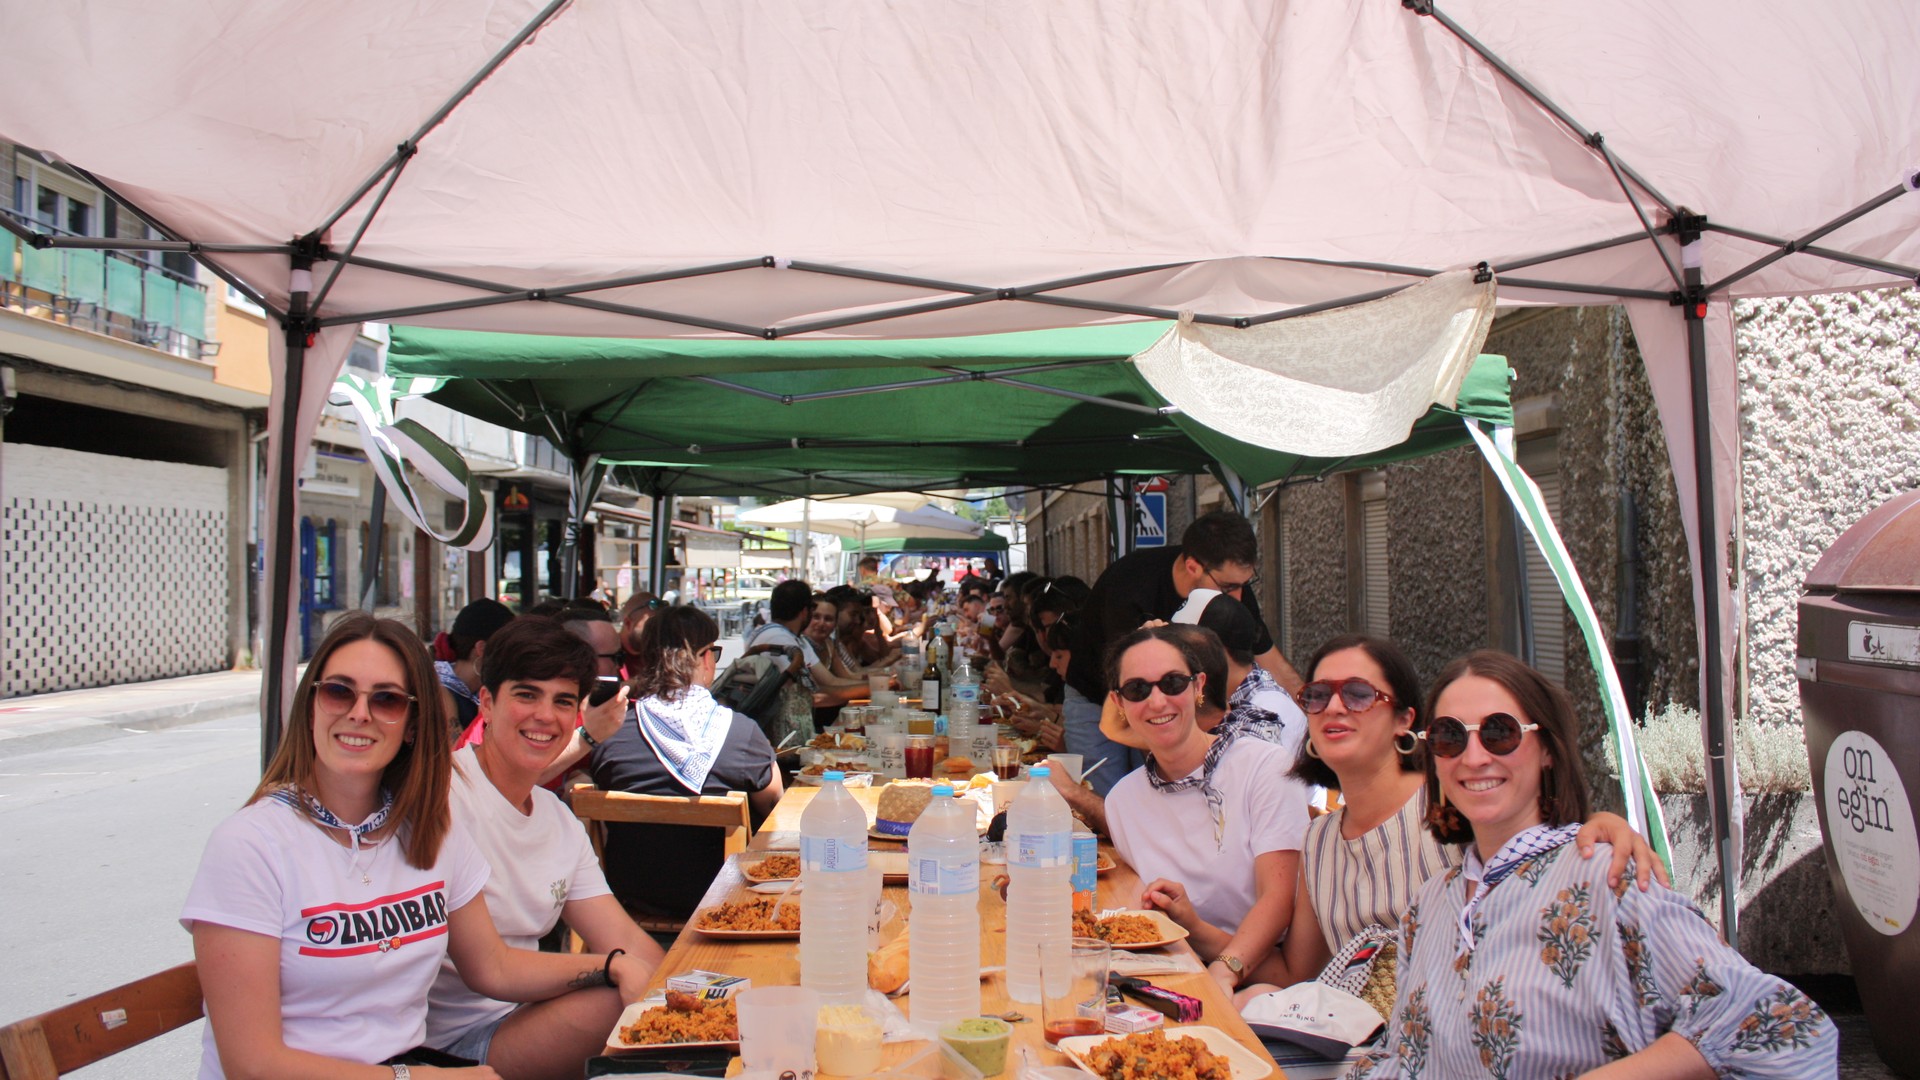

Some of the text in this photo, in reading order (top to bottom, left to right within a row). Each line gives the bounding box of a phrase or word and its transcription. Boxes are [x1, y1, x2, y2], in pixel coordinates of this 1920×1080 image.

[1844, 746, 1876, 783] on
[1838, 785, 1893, 833] egin
[827, 838, 836, 869] ARQUILLO
[339, 891, 448, 945] ZALDIBAR
